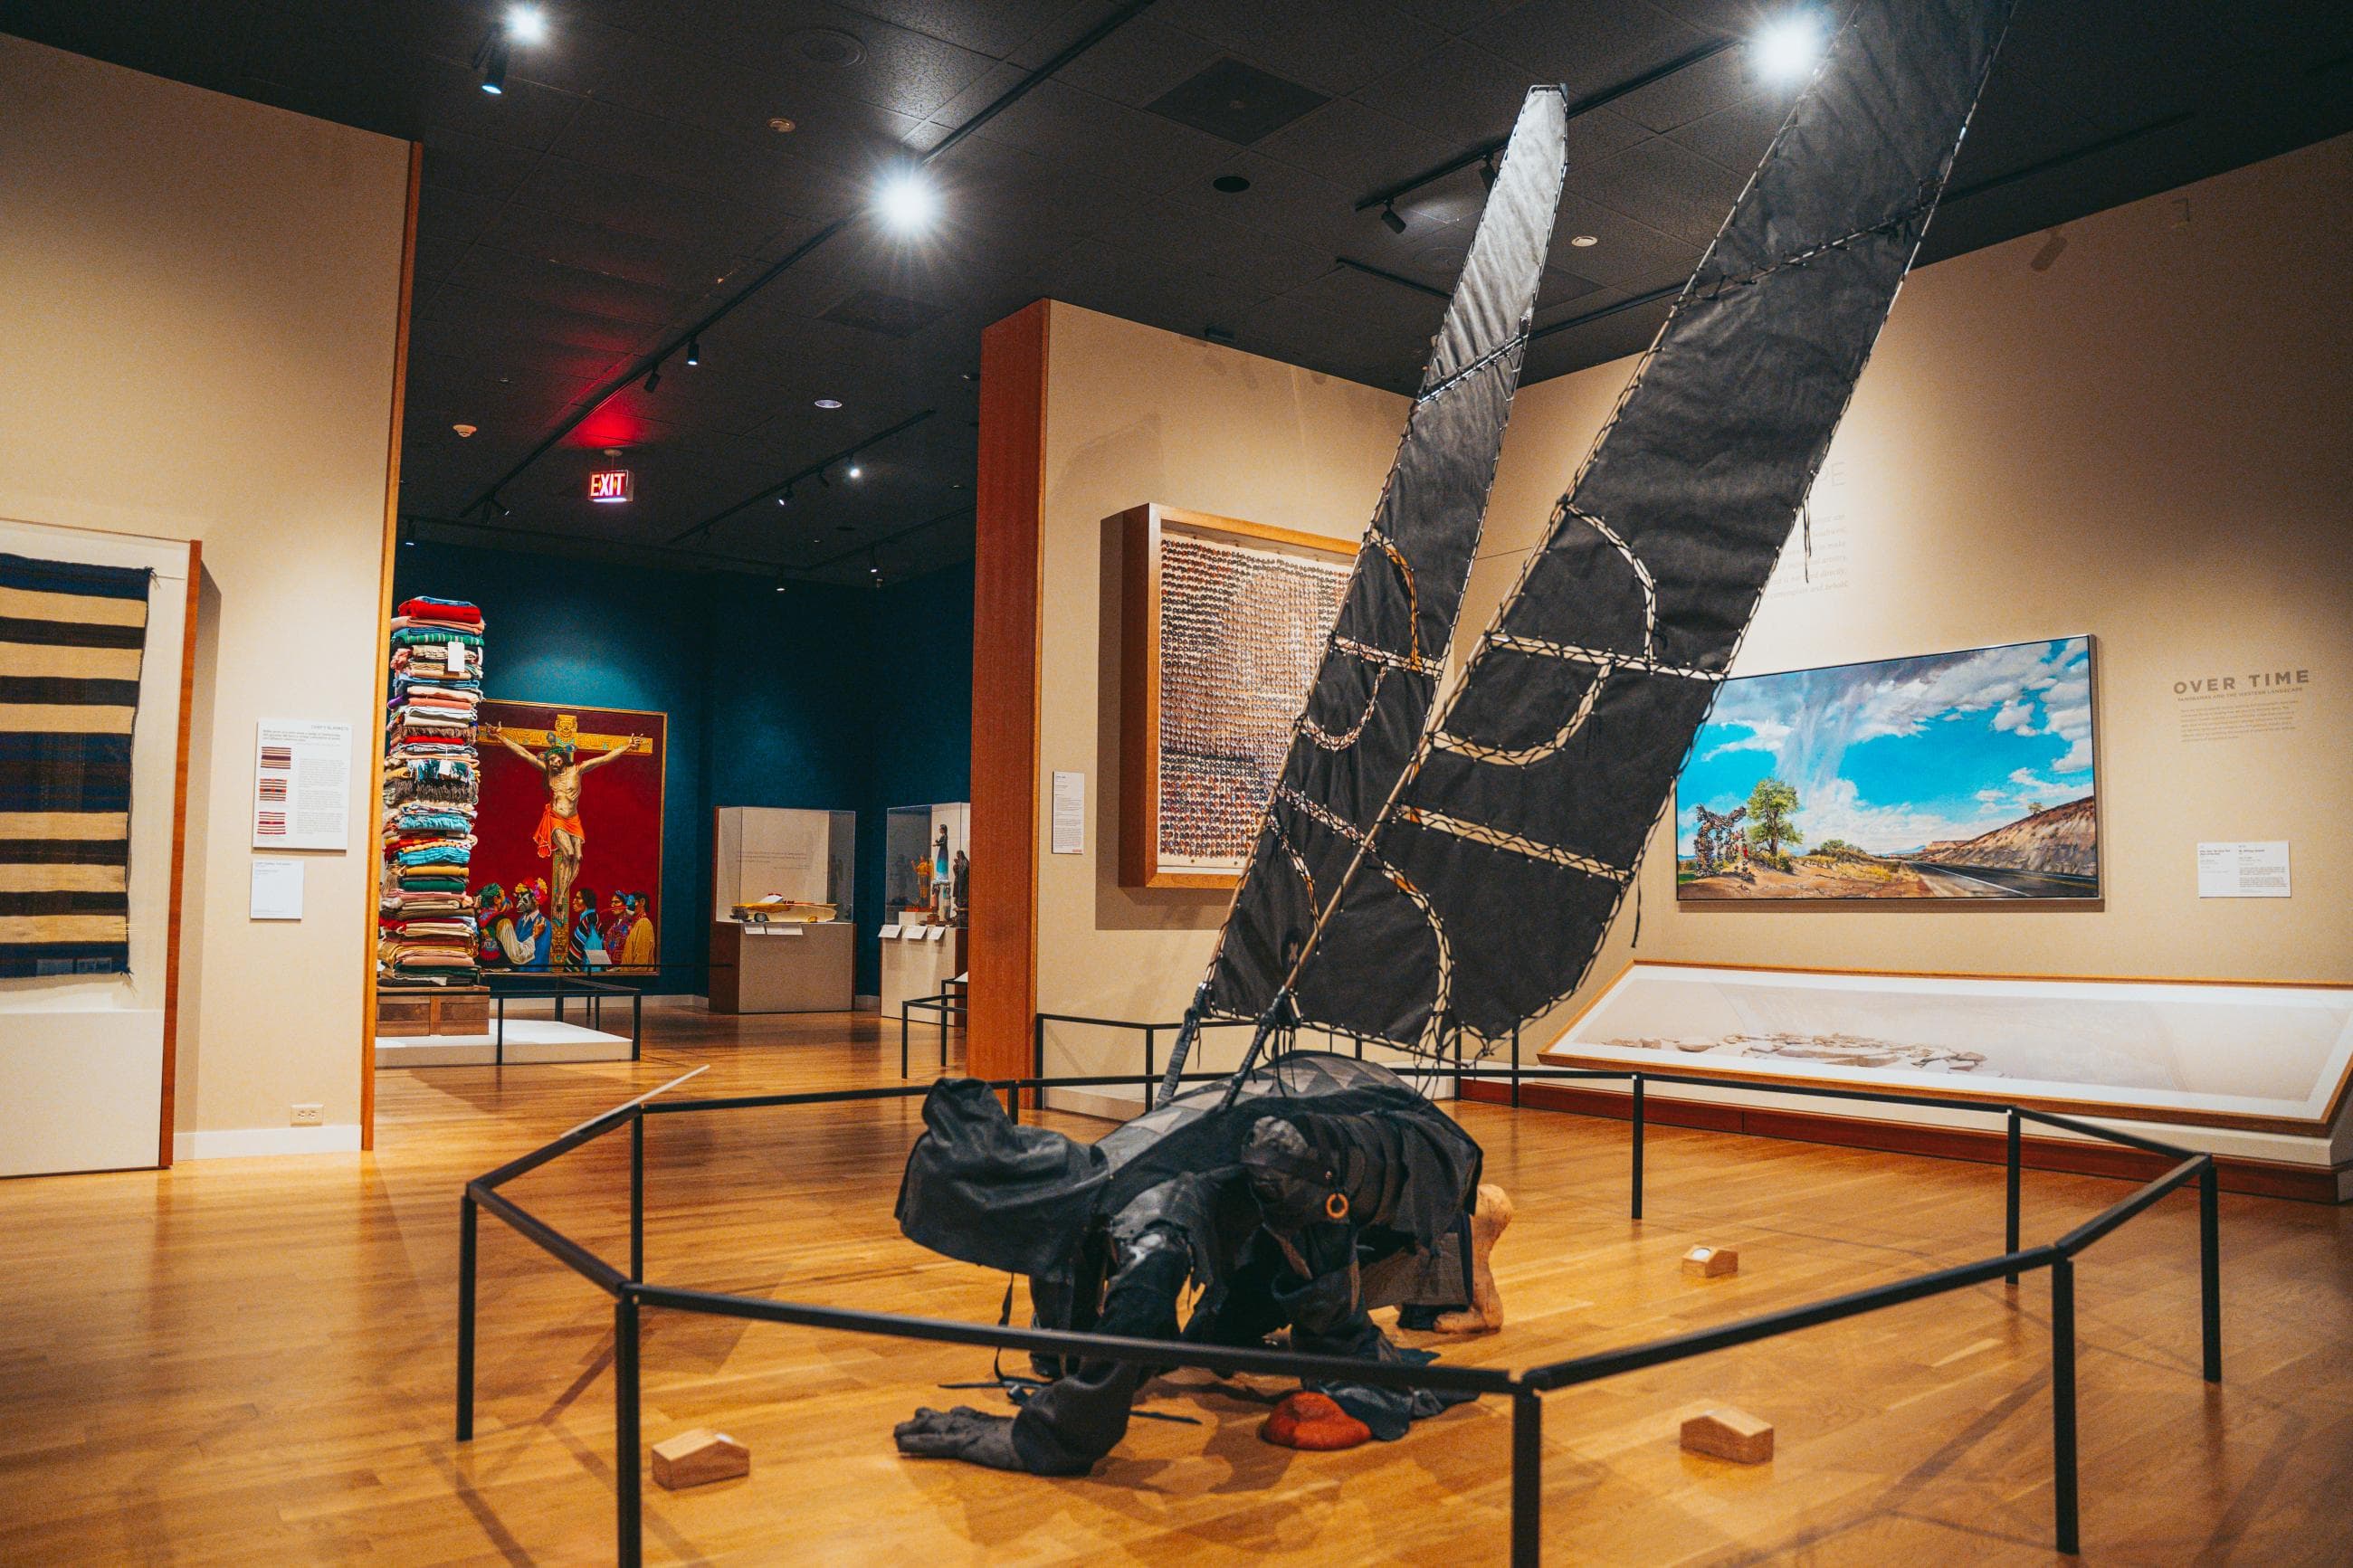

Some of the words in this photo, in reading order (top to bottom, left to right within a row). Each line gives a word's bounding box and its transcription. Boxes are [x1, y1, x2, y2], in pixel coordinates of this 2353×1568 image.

[590, 472, 626, 497] EXIT
[2173, 676, 2236, 695] OVER
[2248, 669, 2310, 688] TIME
